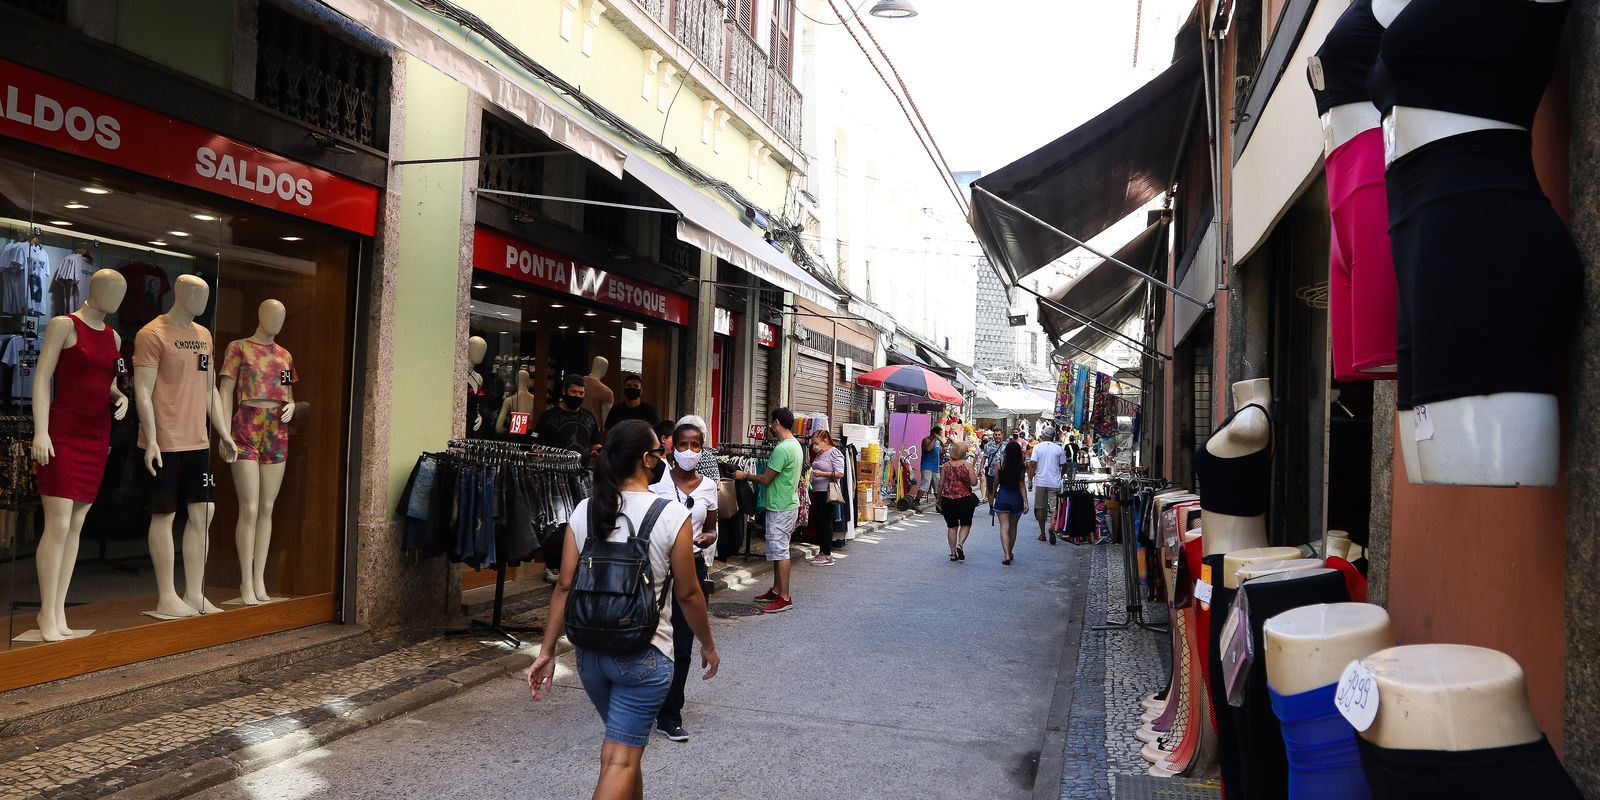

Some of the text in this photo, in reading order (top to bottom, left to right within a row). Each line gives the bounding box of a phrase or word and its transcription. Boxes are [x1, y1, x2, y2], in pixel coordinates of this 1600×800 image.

[0, 85, 121, 150] LDOS
[195, 146, 313, 206] SALDOS
[506, 245, 566, 285] PONTA
[608, 278, 666, 314] ESTOQUE
